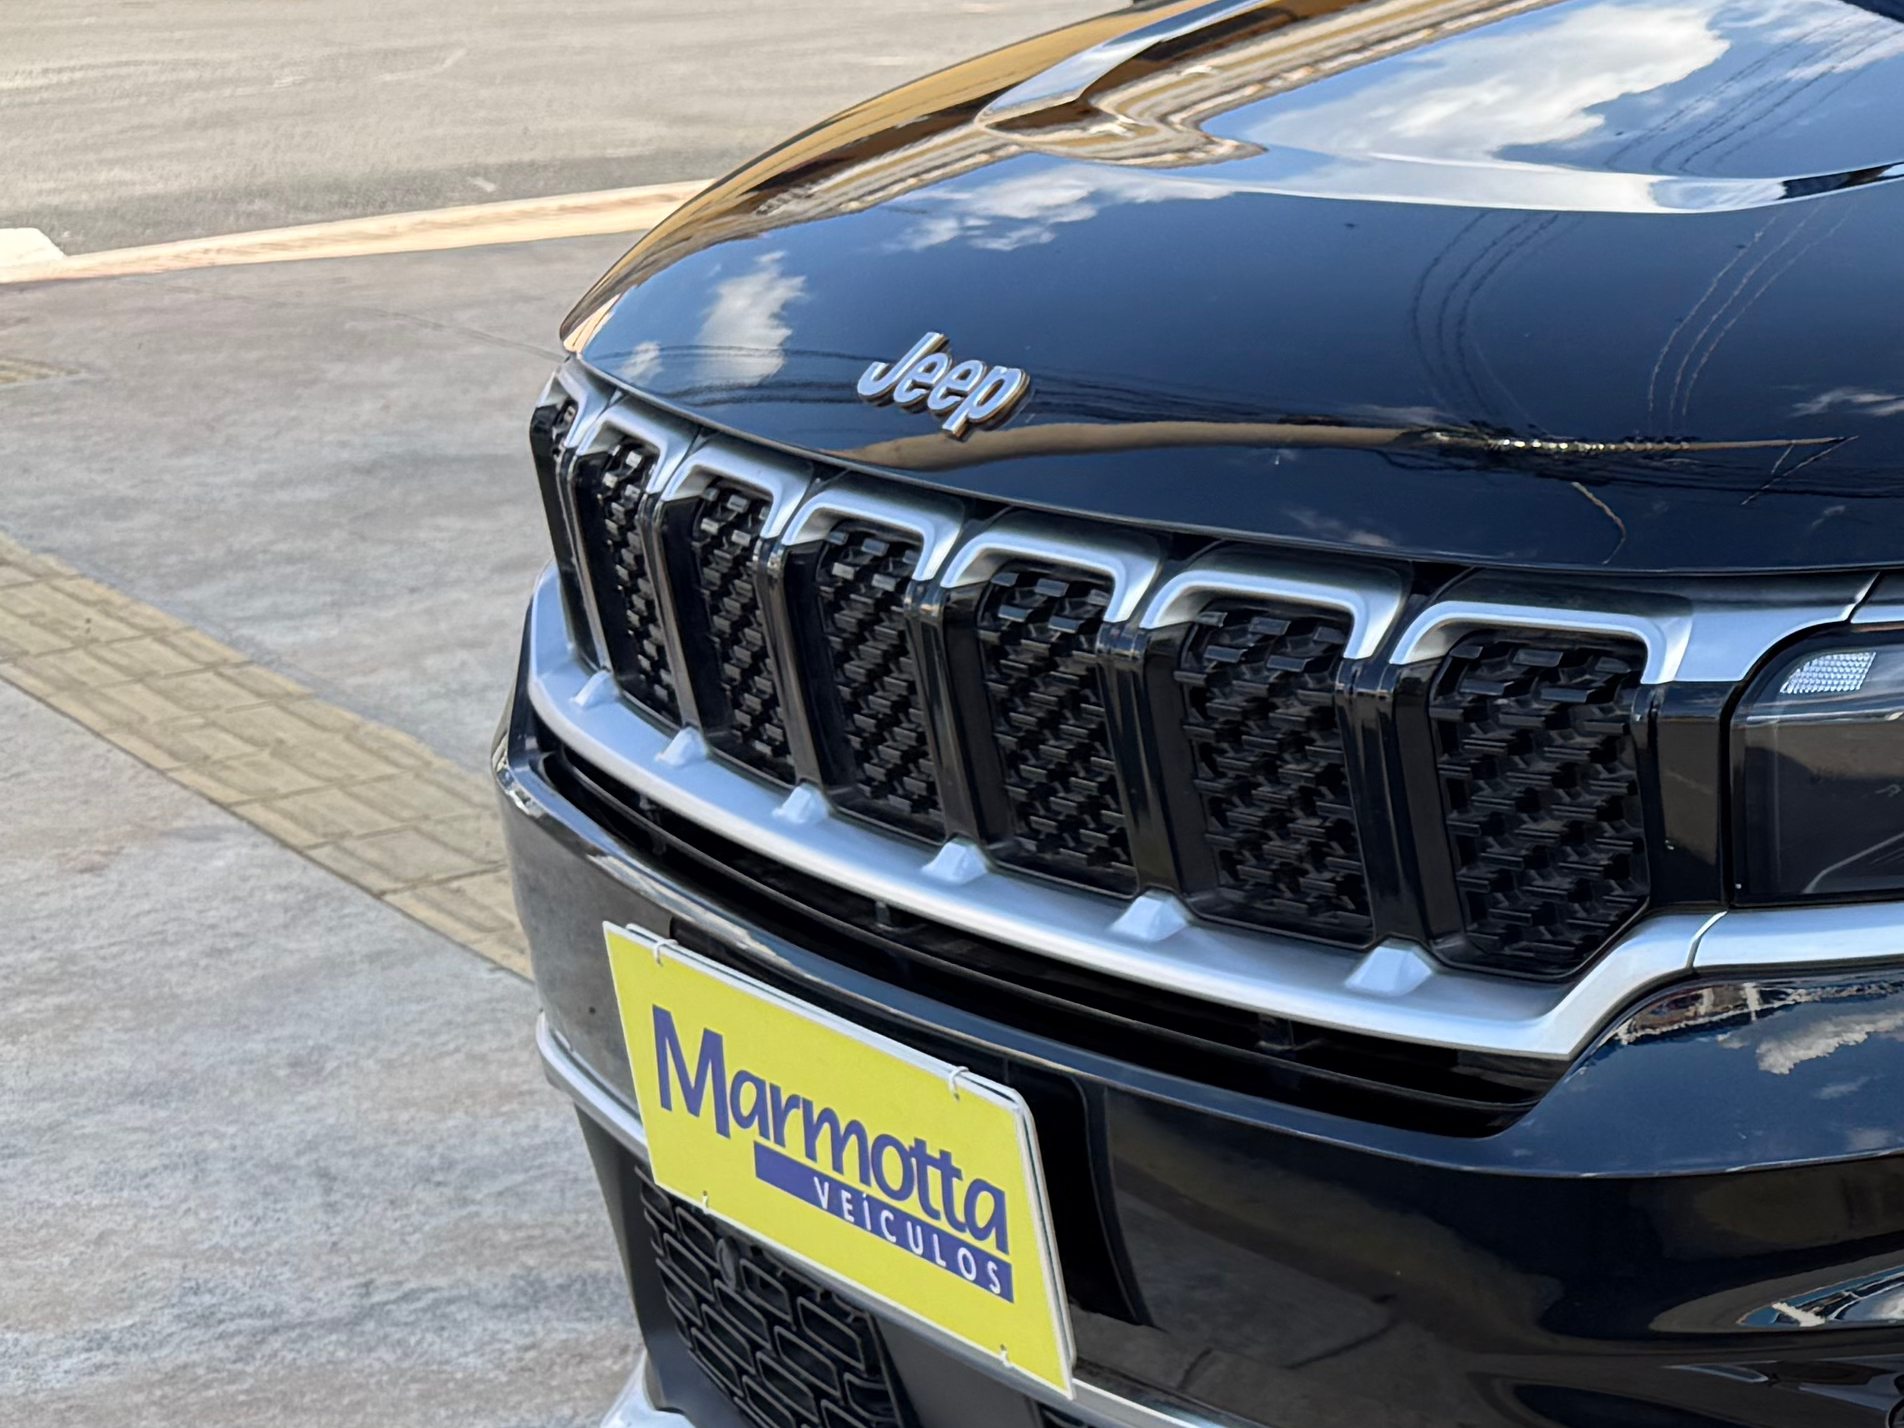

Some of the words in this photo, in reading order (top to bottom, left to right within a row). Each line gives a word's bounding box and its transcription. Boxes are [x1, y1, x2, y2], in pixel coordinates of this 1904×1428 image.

[857, 331, 1030, 441] Jeep
[651, 1004, 1011, 1256] Marmotta
[813, 1176, 1002, 1296] VEÍCULOS
